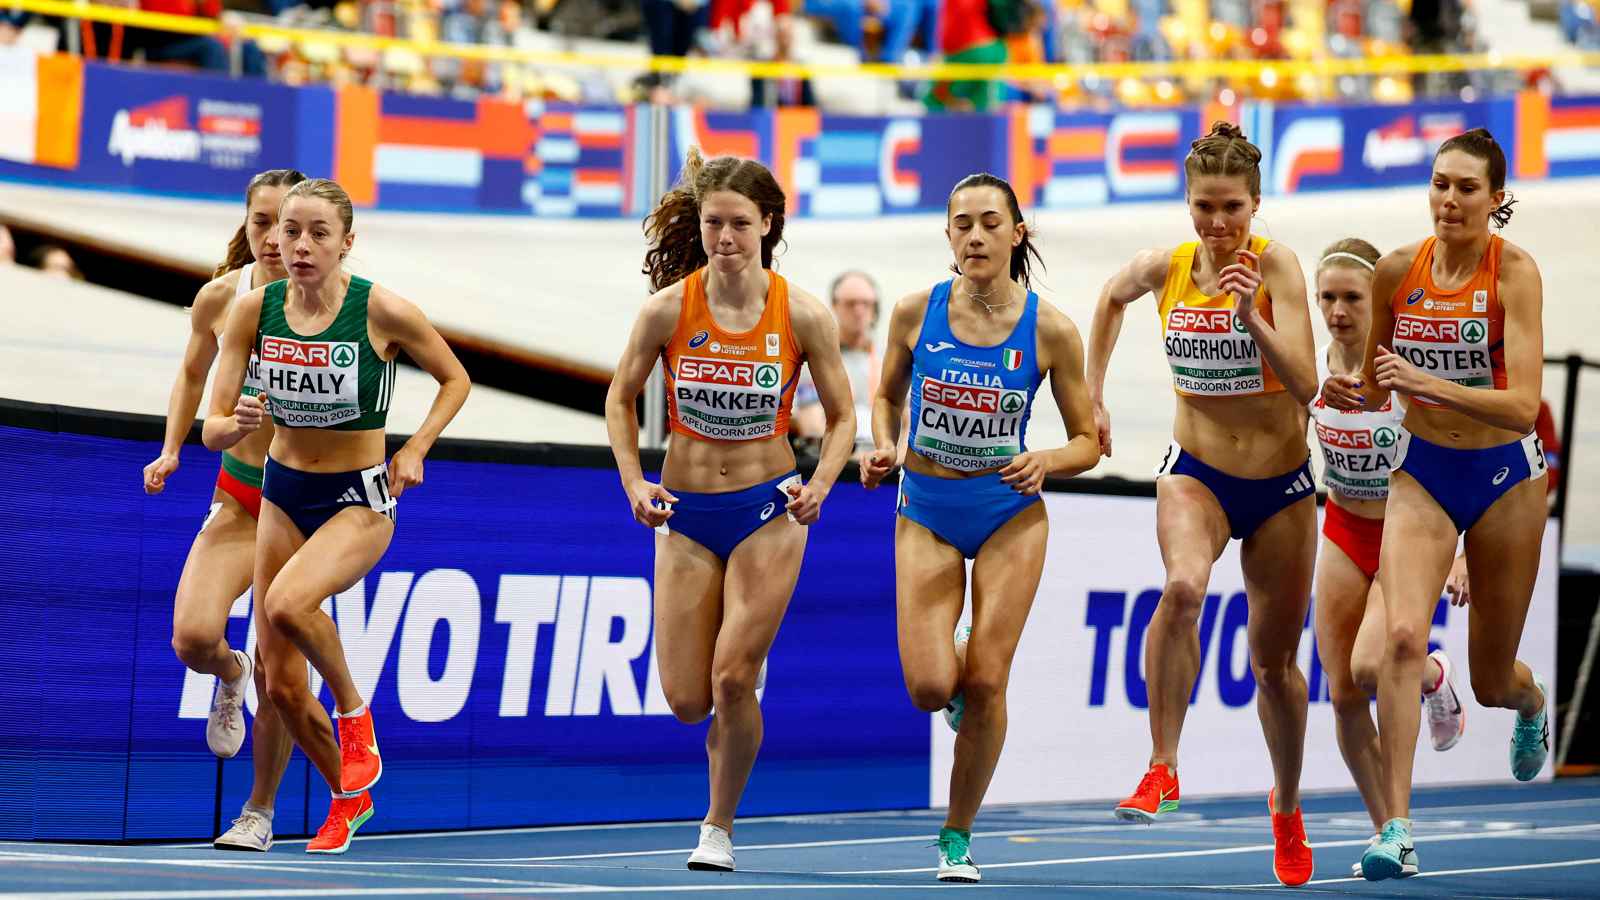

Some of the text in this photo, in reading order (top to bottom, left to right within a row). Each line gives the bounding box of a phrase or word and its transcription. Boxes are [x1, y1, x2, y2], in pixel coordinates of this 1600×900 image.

[1170, 311, 1229, 330] SPAR
[1397, 319, 1457, 340] SPAR
[263, 341, 327, 364] SPAR
[1165, 332, 1257, 360] SÖDERHOLM
[1395, 345, 1488, 370] KOSTER
[269, 368, 346, 394] HEALY
[680, 361, 752, 383] SPAR
[941, 368, 1004, 388] ITALIA
[1188, 369, 1205, 377] RUN
[1206, 369, 1237, 378] CLEAN
[1176, 377, 1260, 392] APELDOORN 2025
[282, 401, 301, 409] RUN
[302, 403, 333, 411] CLEAN
[677, 387, 776, 410] BAKKER
[924, 383, 995, 410] SPAR
[274, 405, 328, 423] DOORN
[330, 408, 357, 421] 2025
[700, 412, 720, 423] RUN
[721, 416, 752, 425] CLEAN
[921, 407, 1017, 439] CAVALLI
[682, 415, 772, 437] APELDOORN 2025
[1316, 425, 1370, 446] SPAR
[940, 442, 960, 453] RUN
[1324, 447, 1391, 473] BREZA
[495, 574, 768, 716] TIR
